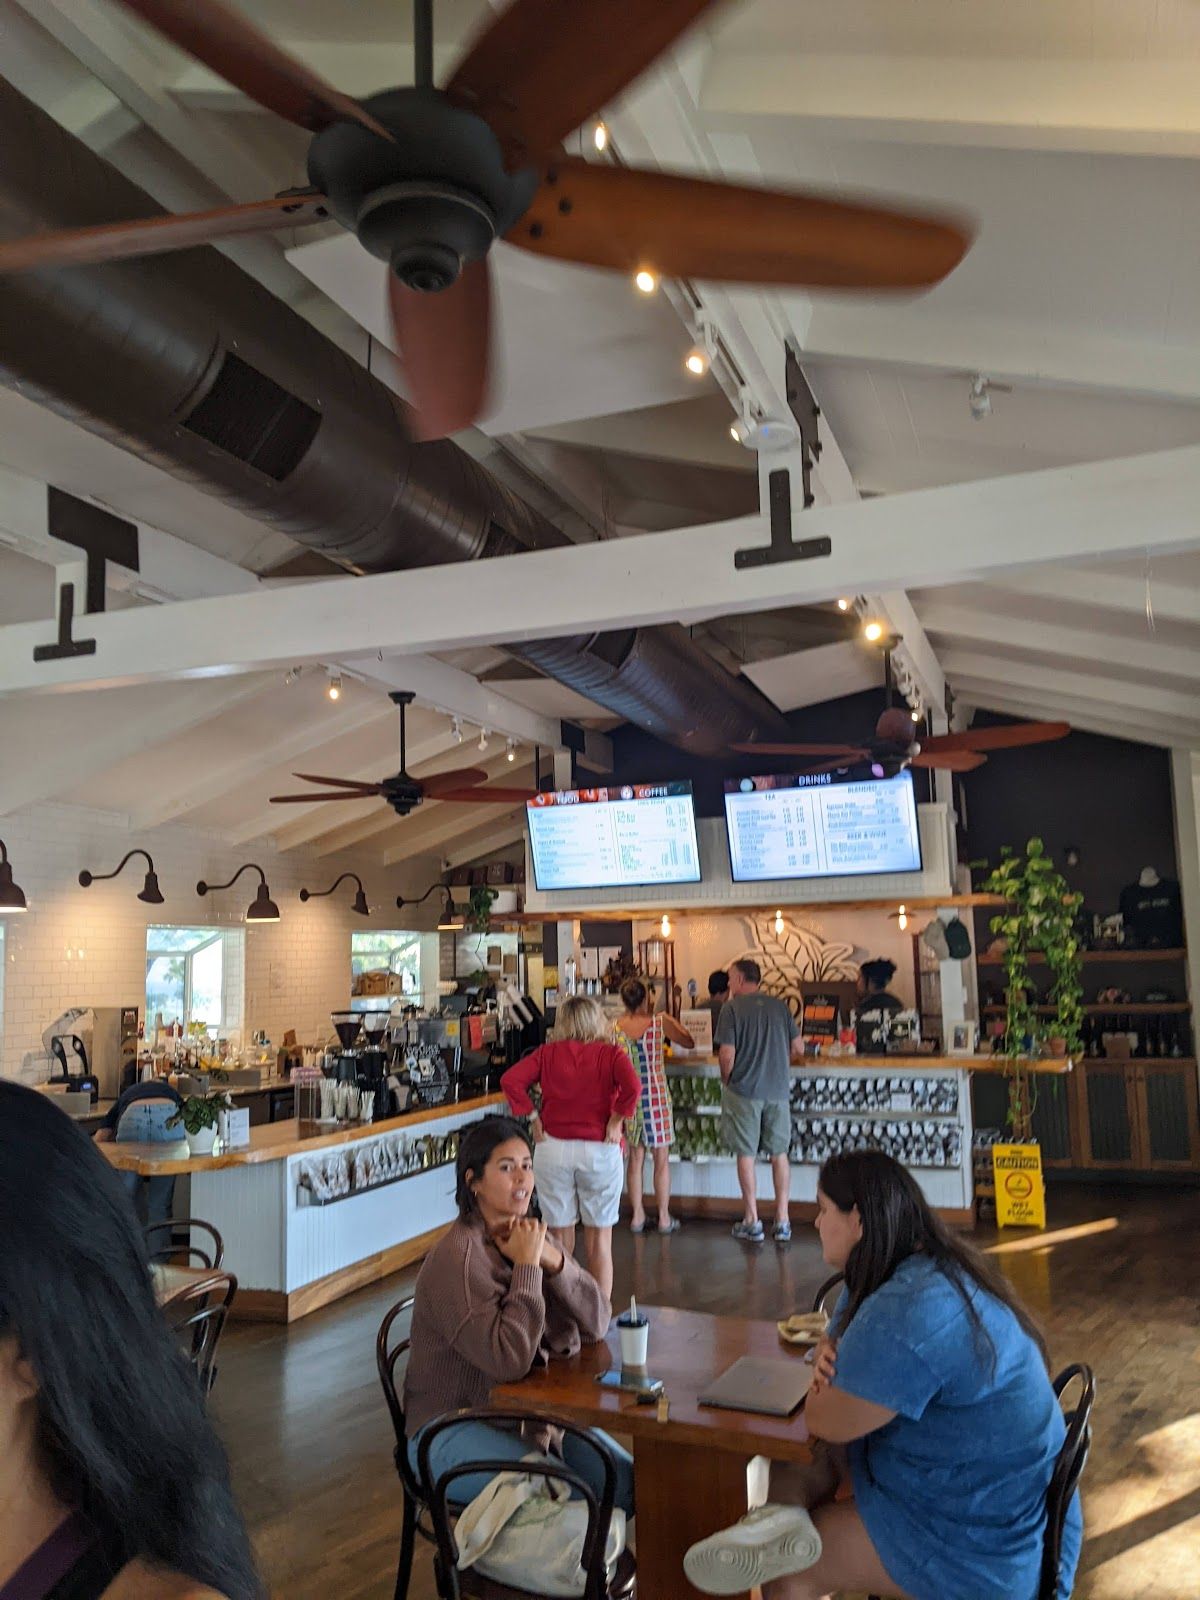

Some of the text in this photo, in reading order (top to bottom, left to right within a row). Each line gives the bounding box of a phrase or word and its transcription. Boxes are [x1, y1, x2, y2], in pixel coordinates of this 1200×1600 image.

[798, 774, 831, 786] DRINKS
[639, 786, 668, 798] COFFEE
[557, 794, 580, 805] FOOD
[996, 1157, 1038, 1168] CAUTION
